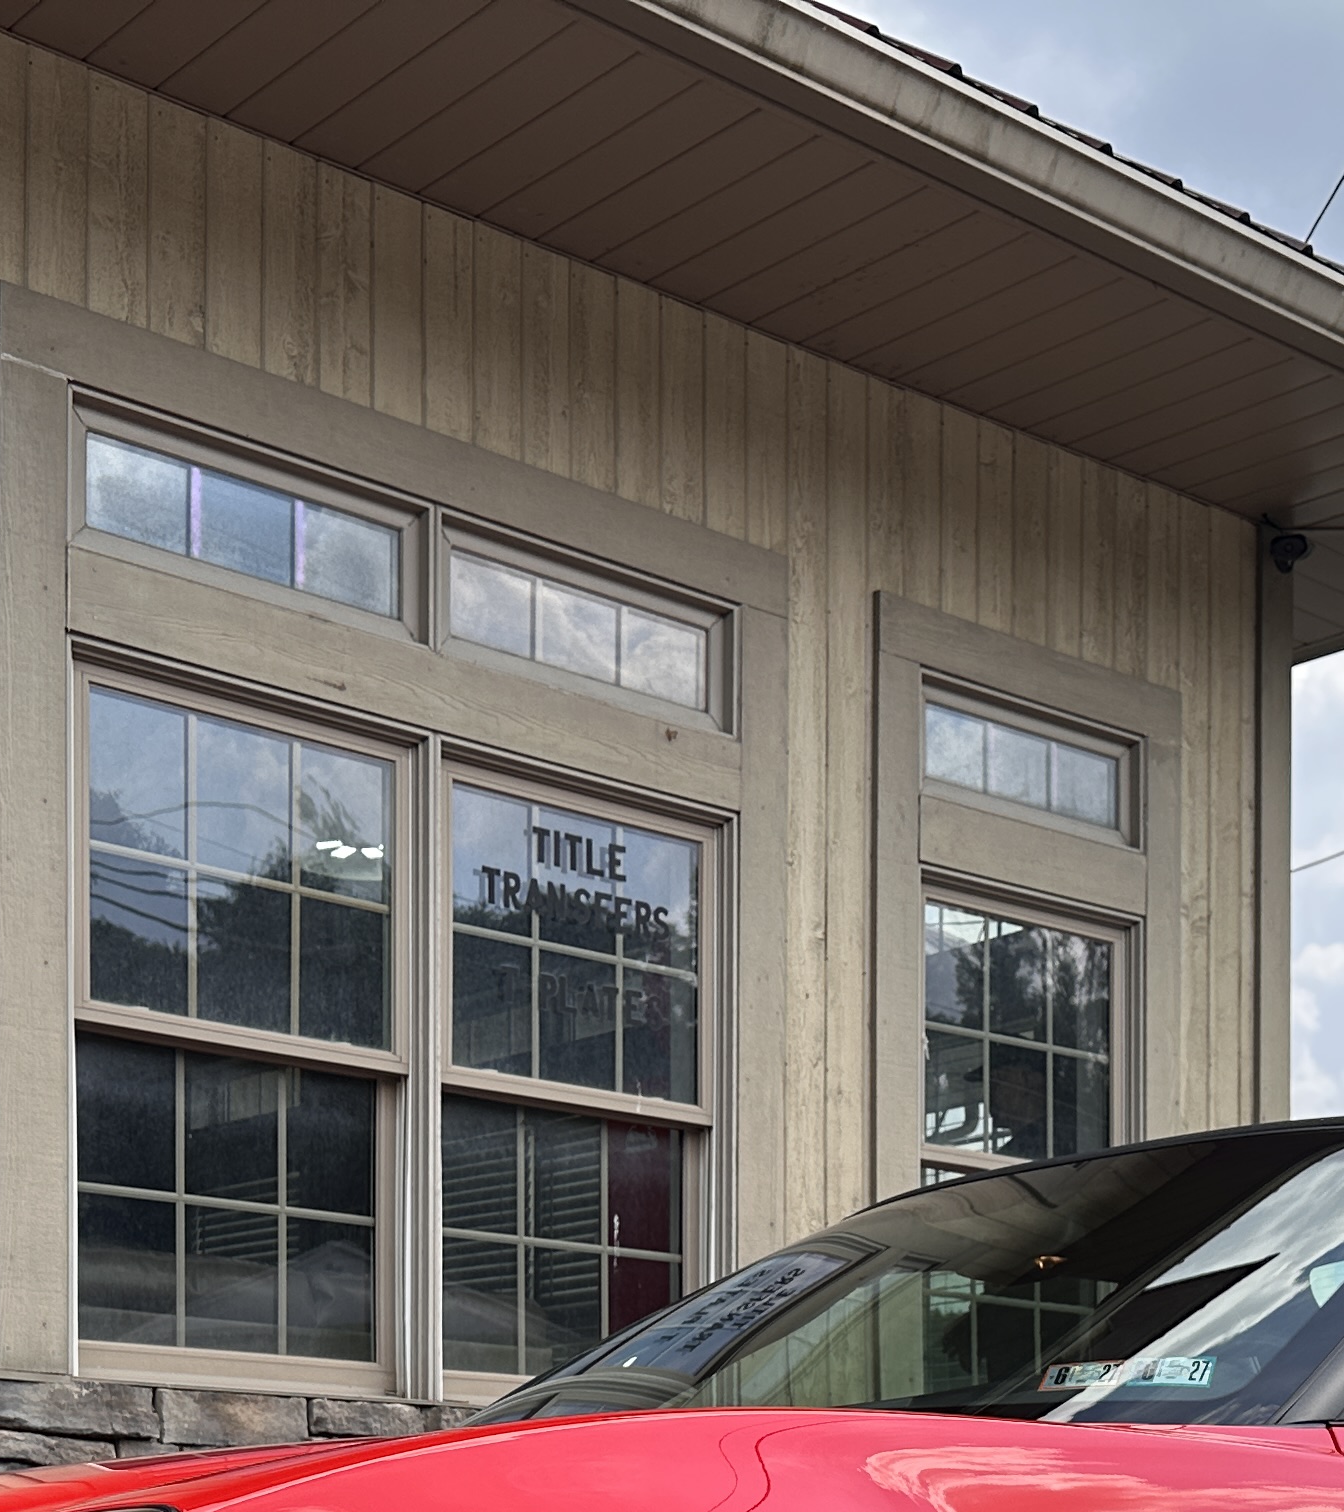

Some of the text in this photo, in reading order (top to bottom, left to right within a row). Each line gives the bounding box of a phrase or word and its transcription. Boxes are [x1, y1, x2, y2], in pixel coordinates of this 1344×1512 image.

[532, 826, 627, 882] TITLE
[482, 865, 670, 941] TRANSFERS
[1054, 1366, 1070, 1385] 6
[1188, 1360, 1210, 1382] 27
